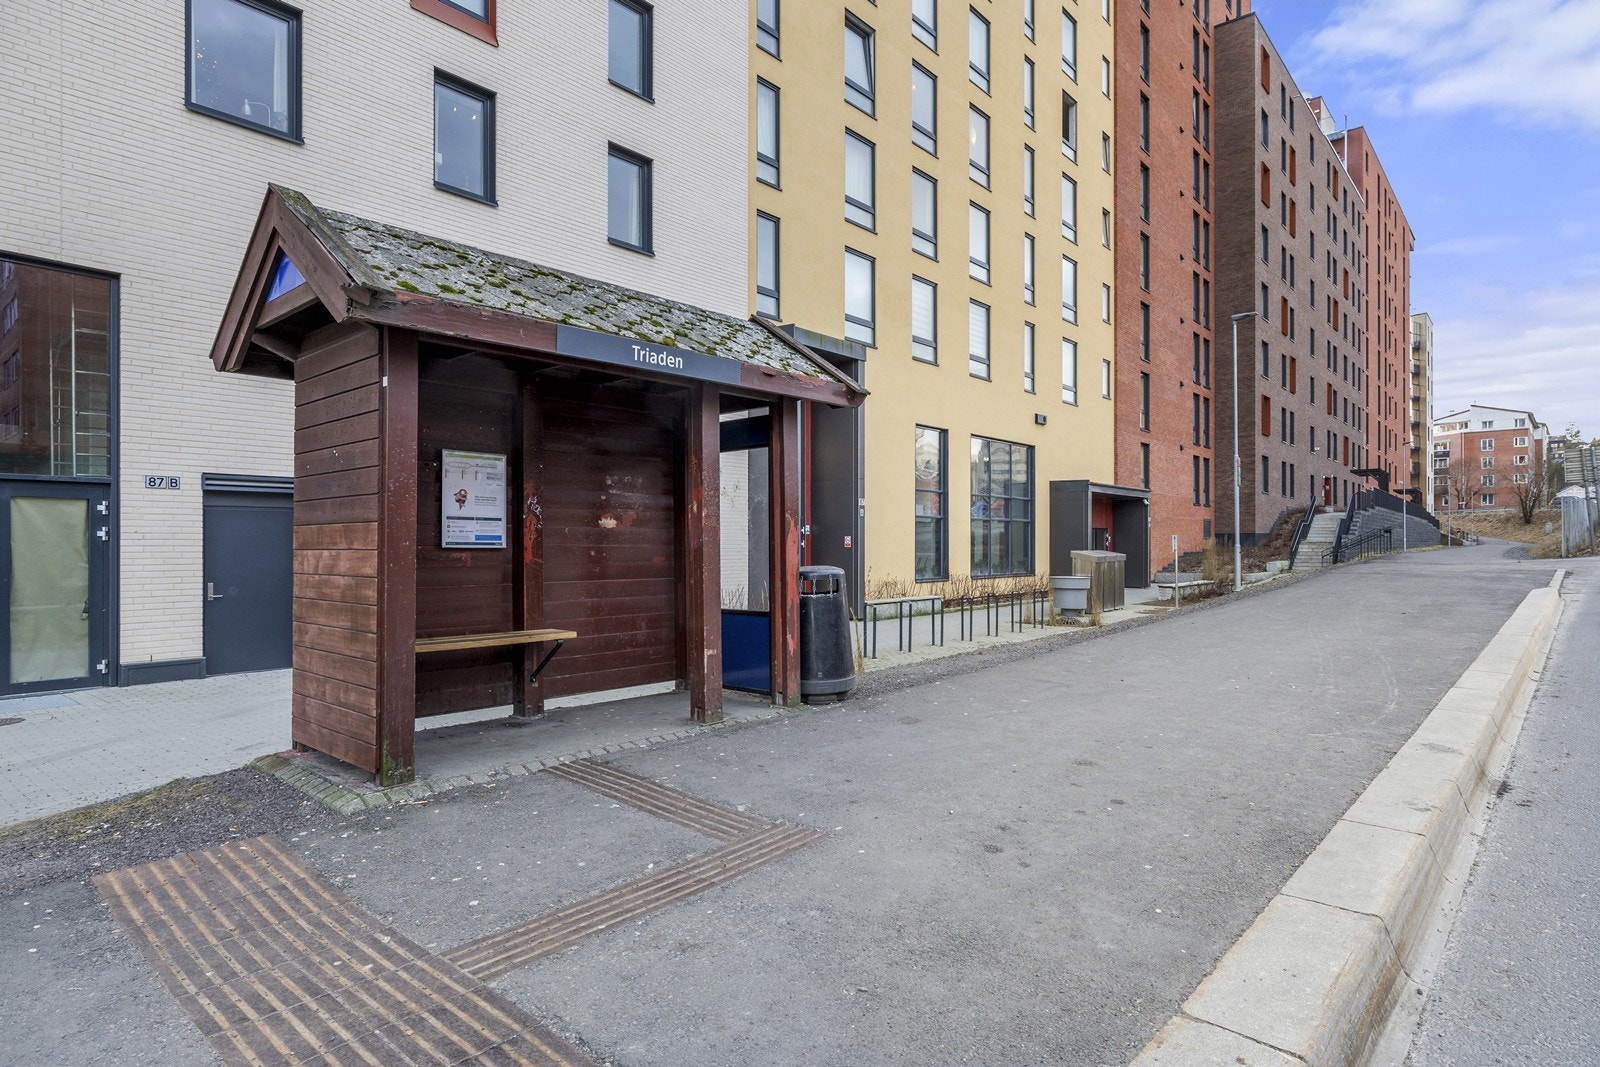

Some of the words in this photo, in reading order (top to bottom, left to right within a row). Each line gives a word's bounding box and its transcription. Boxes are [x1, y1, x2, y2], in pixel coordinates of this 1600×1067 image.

[632, 345, 683, 368] Triaden
[148, 477, 164, 487] 87
[170, 478, 178, 488] B
